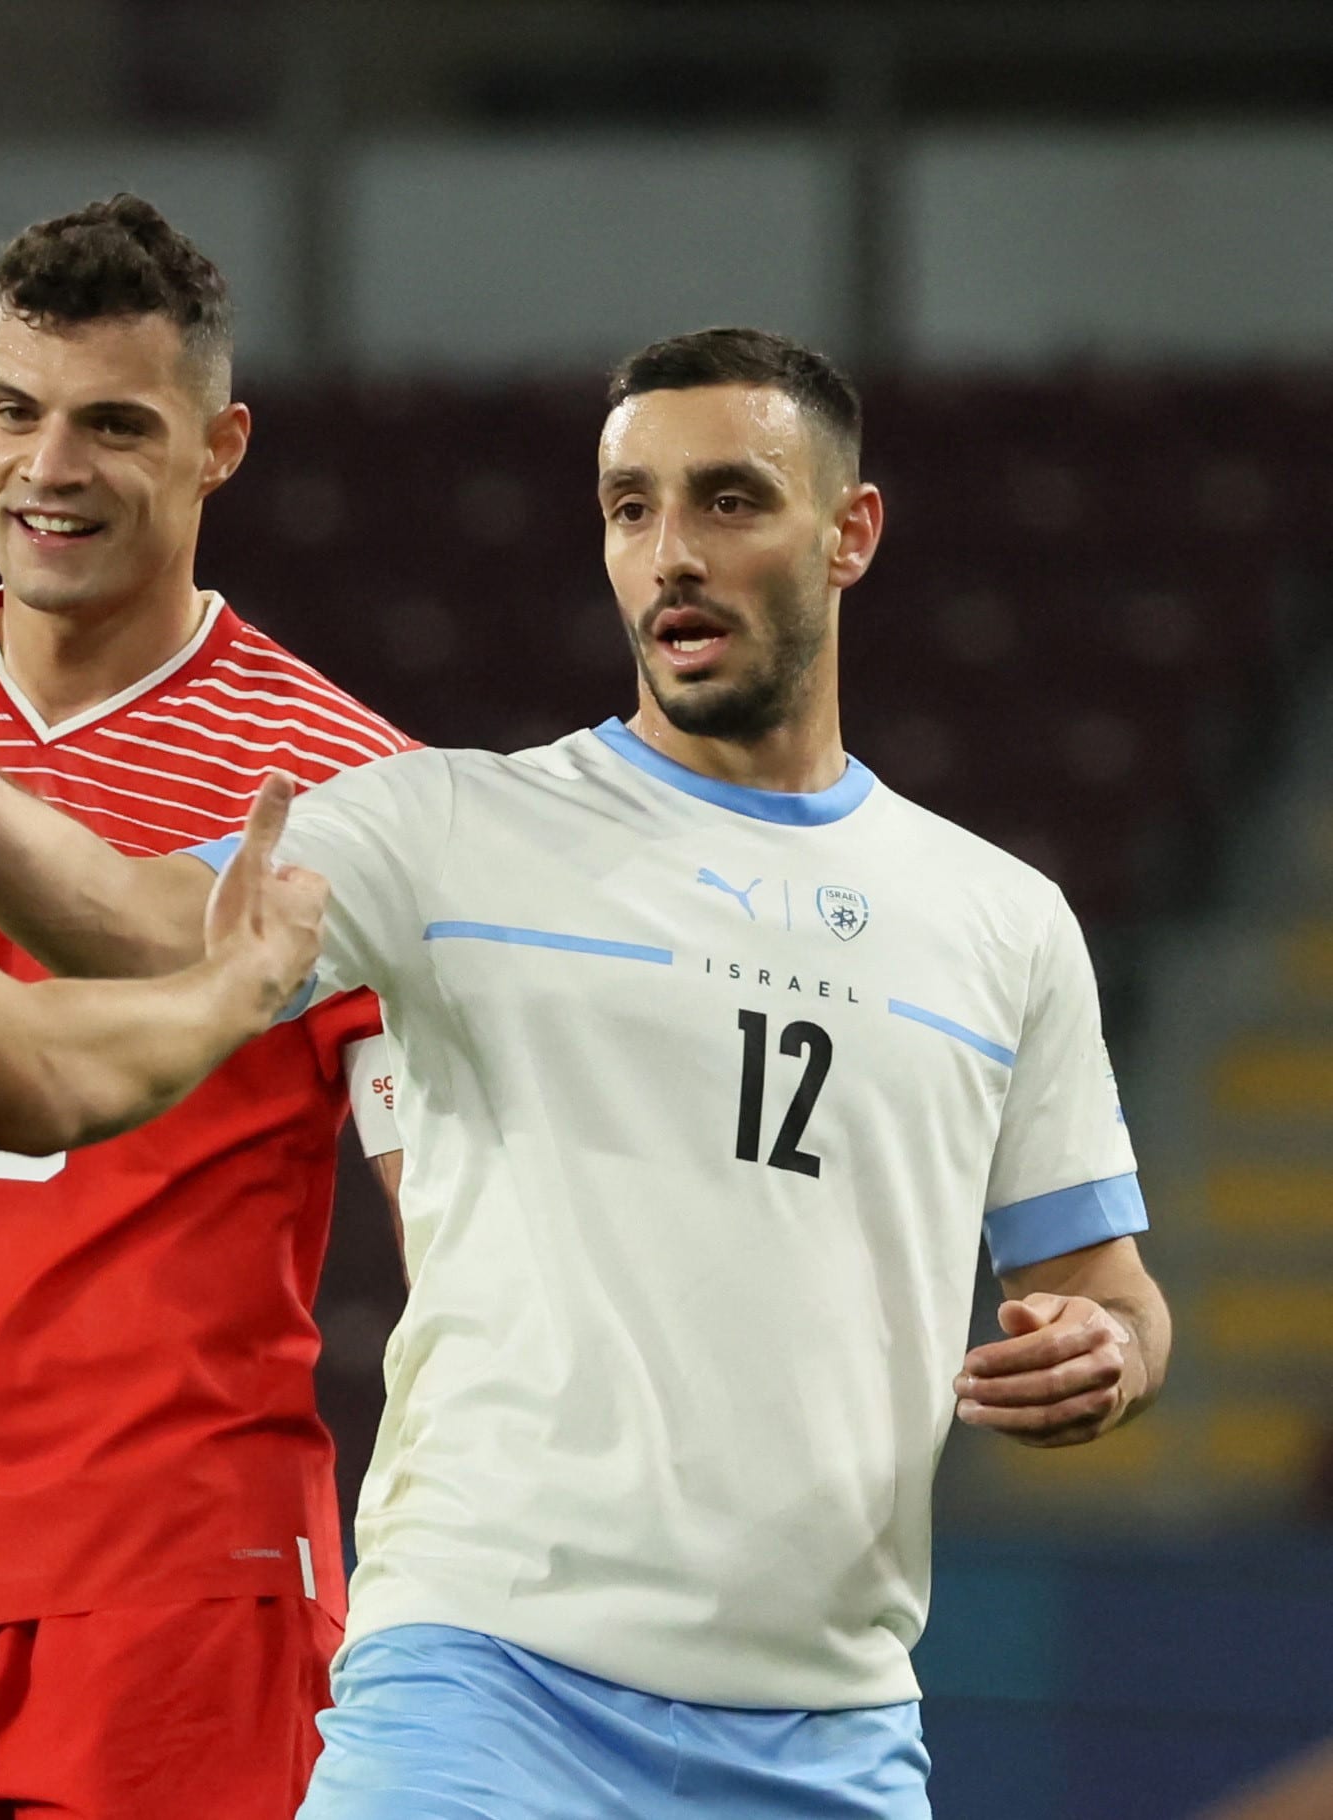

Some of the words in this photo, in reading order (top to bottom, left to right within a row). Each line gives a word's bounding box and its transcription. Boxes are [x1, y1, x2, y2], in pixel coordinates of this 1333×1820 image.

[825, 889, 859, 902] ISRAEL
[705, 957, 859, 1004] ISRAEL
[735, 1008, 833, 1179] 12
